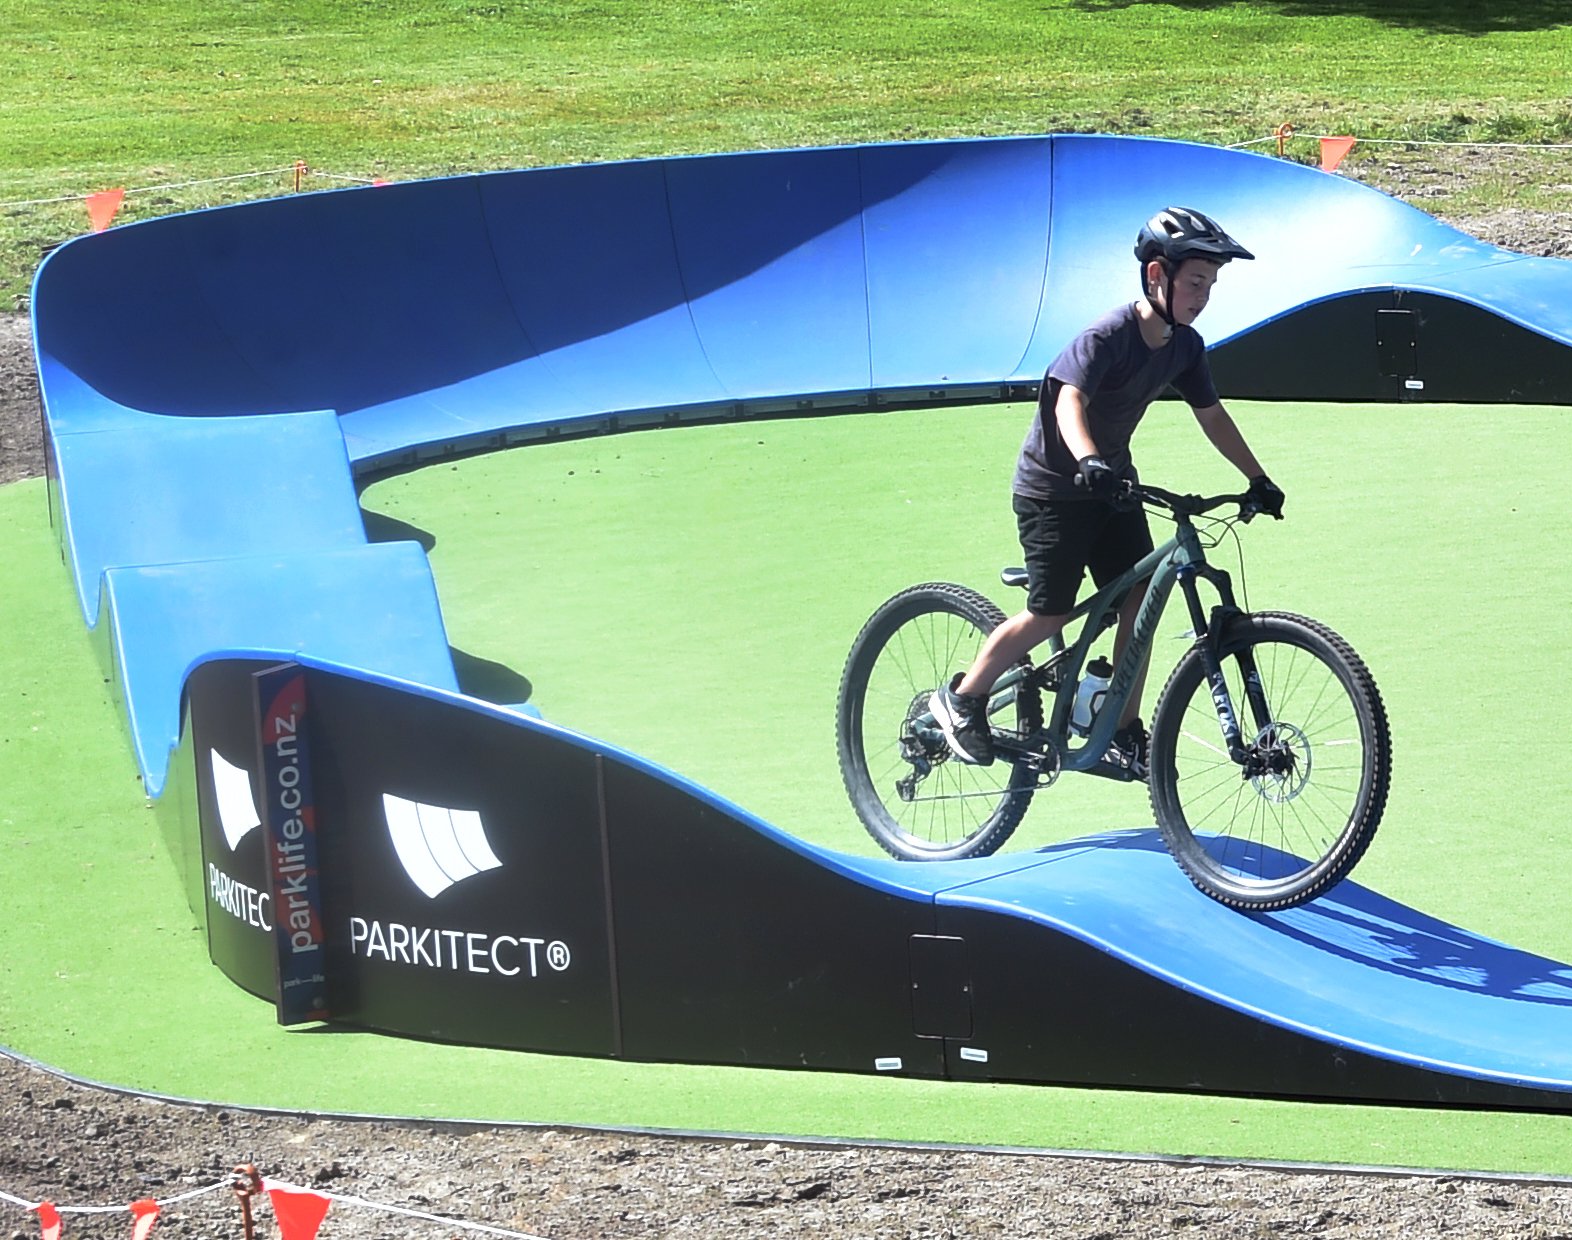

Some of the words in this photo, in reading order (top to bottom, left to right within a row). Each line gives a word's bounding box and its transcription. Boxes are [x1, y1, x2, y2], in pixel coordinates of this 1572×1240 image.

[275, 713, 318, 954] parklife.co.nz
[208, 862, 272, 932] PARKITEC
[350, 917, 571, 978] PARKITECT®
